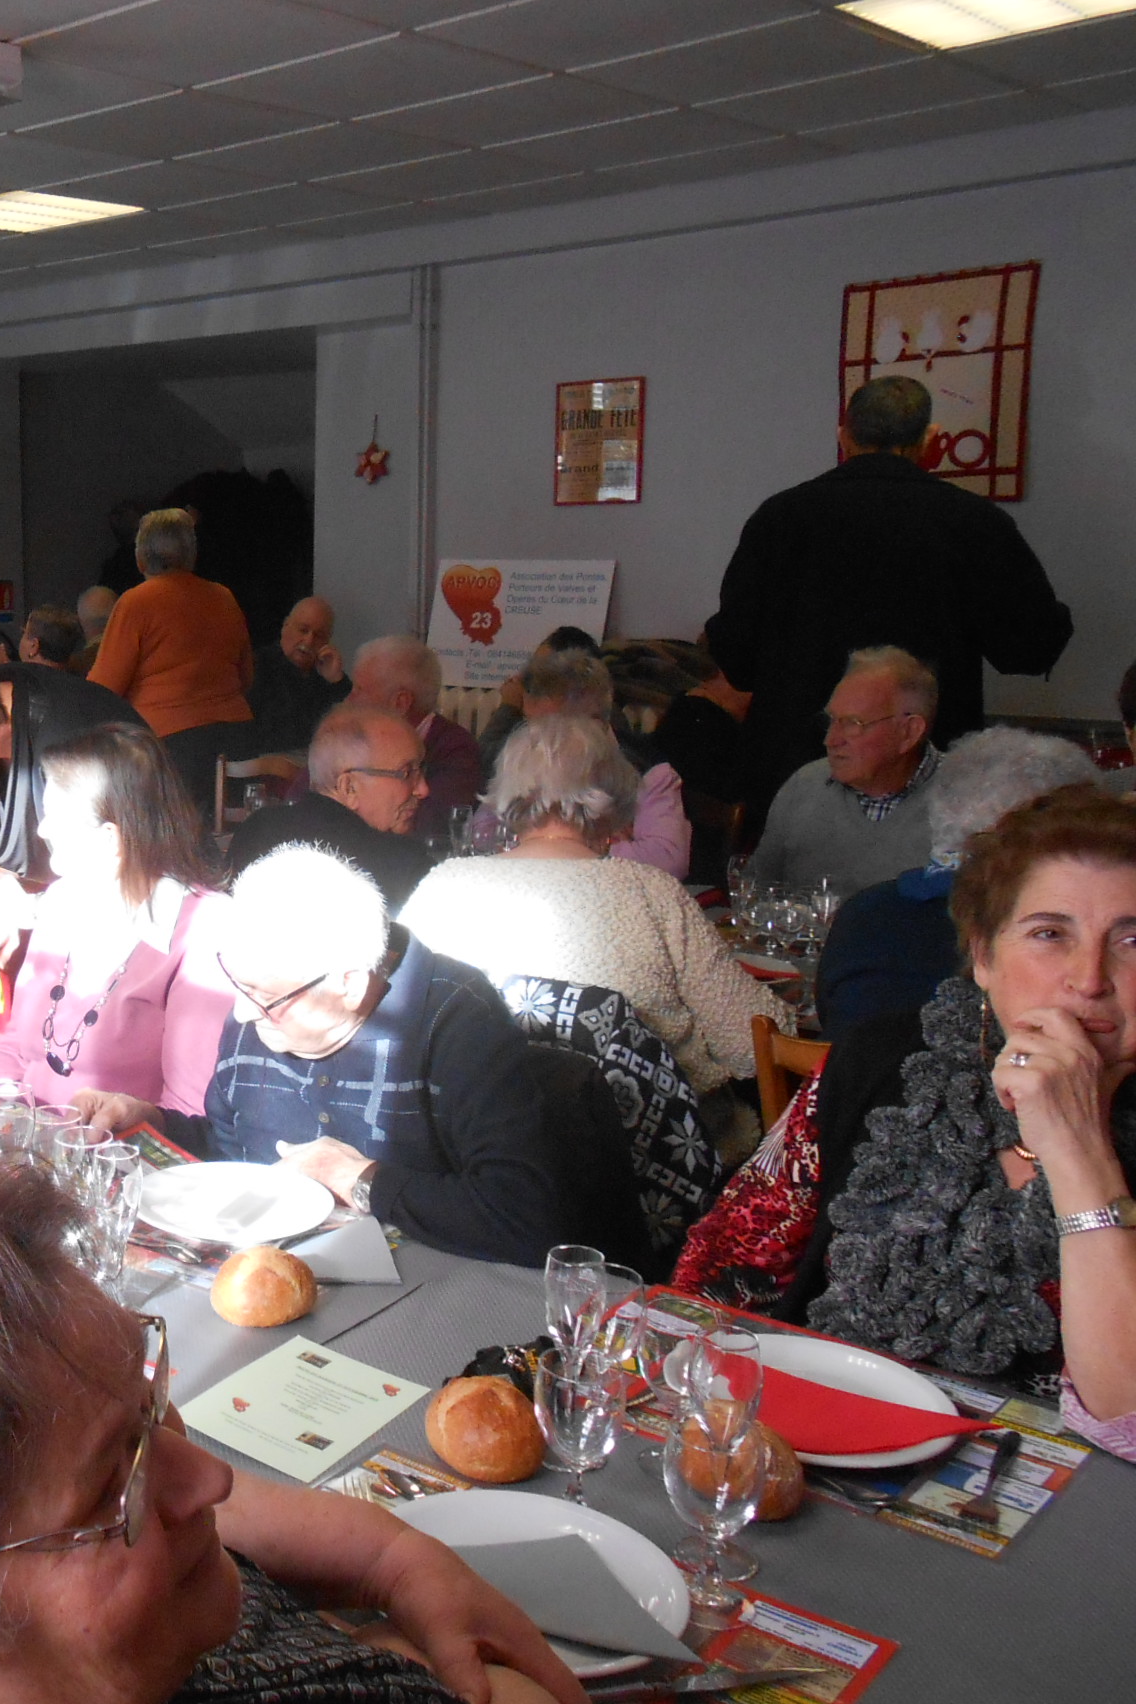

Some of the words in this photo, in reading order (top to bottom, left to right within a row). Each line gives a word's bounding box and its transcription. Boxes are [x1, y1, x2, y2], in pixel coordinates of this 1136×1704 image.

[561, 409, 603, 430] GRANDE
[510, 572, 557, 581] Association
[558, 573, 574, 581] des
[446, 574, 501, 590] APVOC
[508, 583, 543, 593] Porteurs
[544, 584, 556, 592] de
[587, 584, 596, 593] et
[538, 595, 549, 603] du
[504, 606, 543, 615] CREUSE
[469, 611, 493, 629] 23
